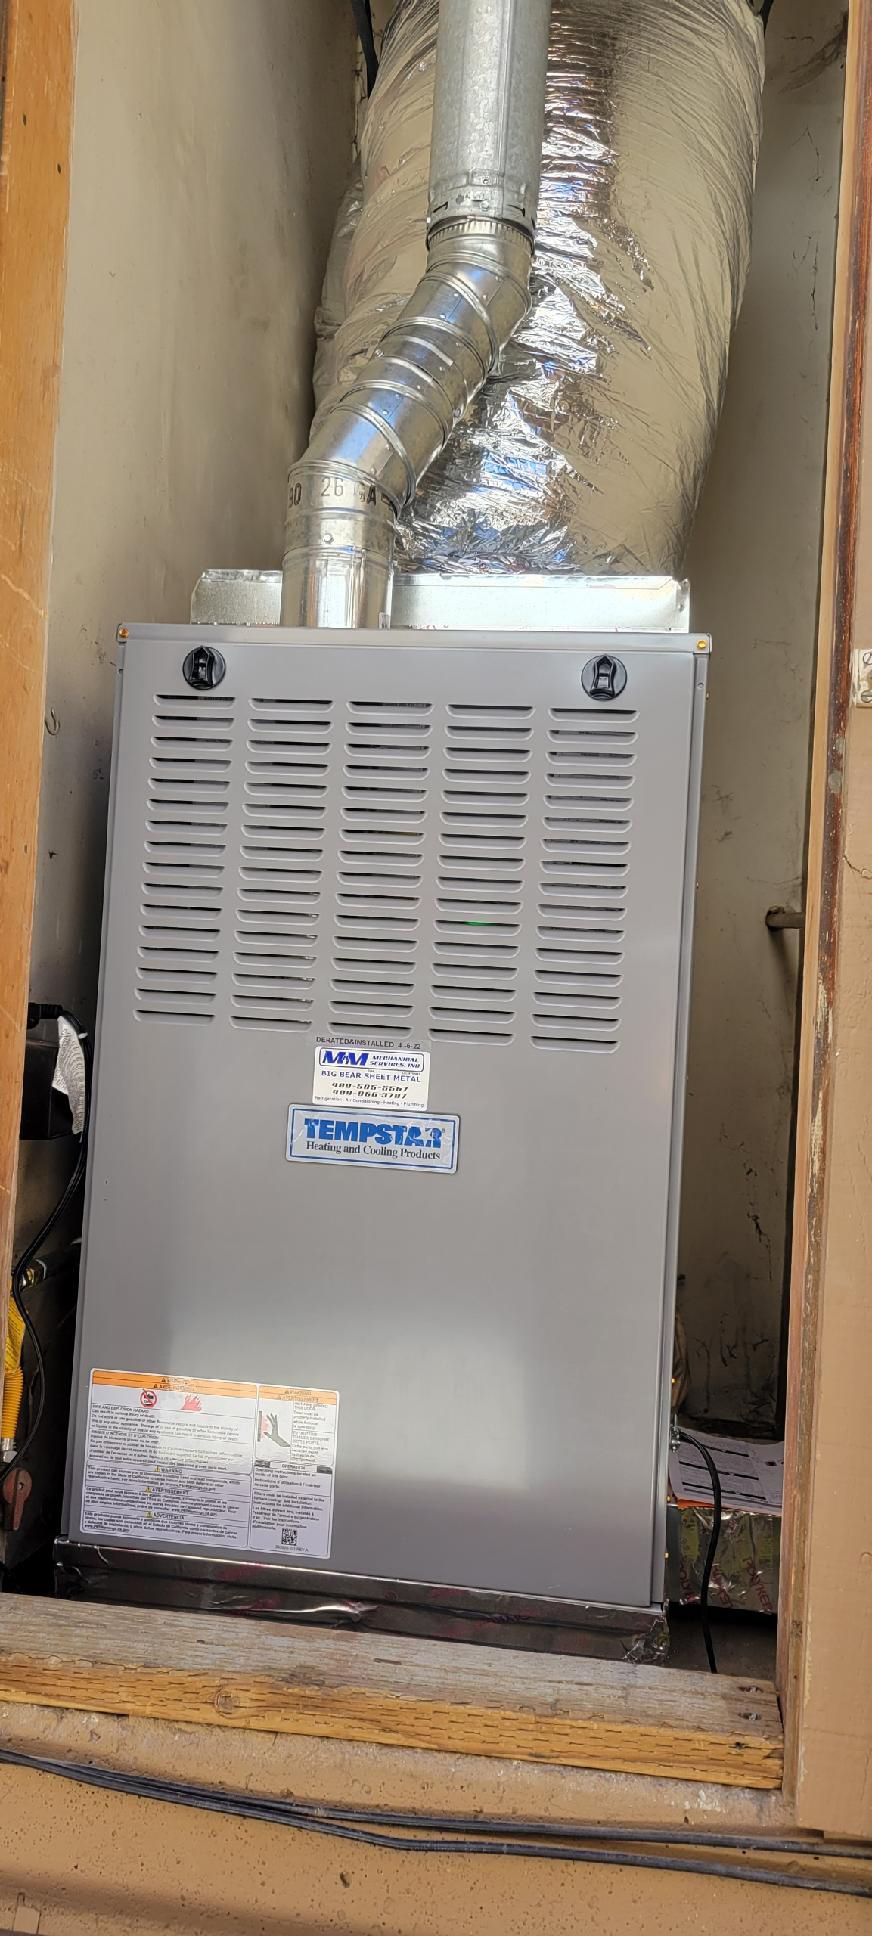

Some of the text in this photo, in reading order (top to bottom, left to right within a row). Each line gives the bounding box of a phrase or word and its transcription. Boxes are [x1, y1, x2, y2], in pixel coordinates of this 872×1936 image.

[320, 477, 344, 496] 26
[321, 1070, 337, 1078] BIG
[340, 1071, 362, 1079] BEAR
[364, 1073, 391, 1081] SHEET
[393, 1074, 421, 1082] METAL
[304, 1117, 442, 1149] TEMPSTAR
[306, 1140, 441, 1160] Heating and Cooling Products
